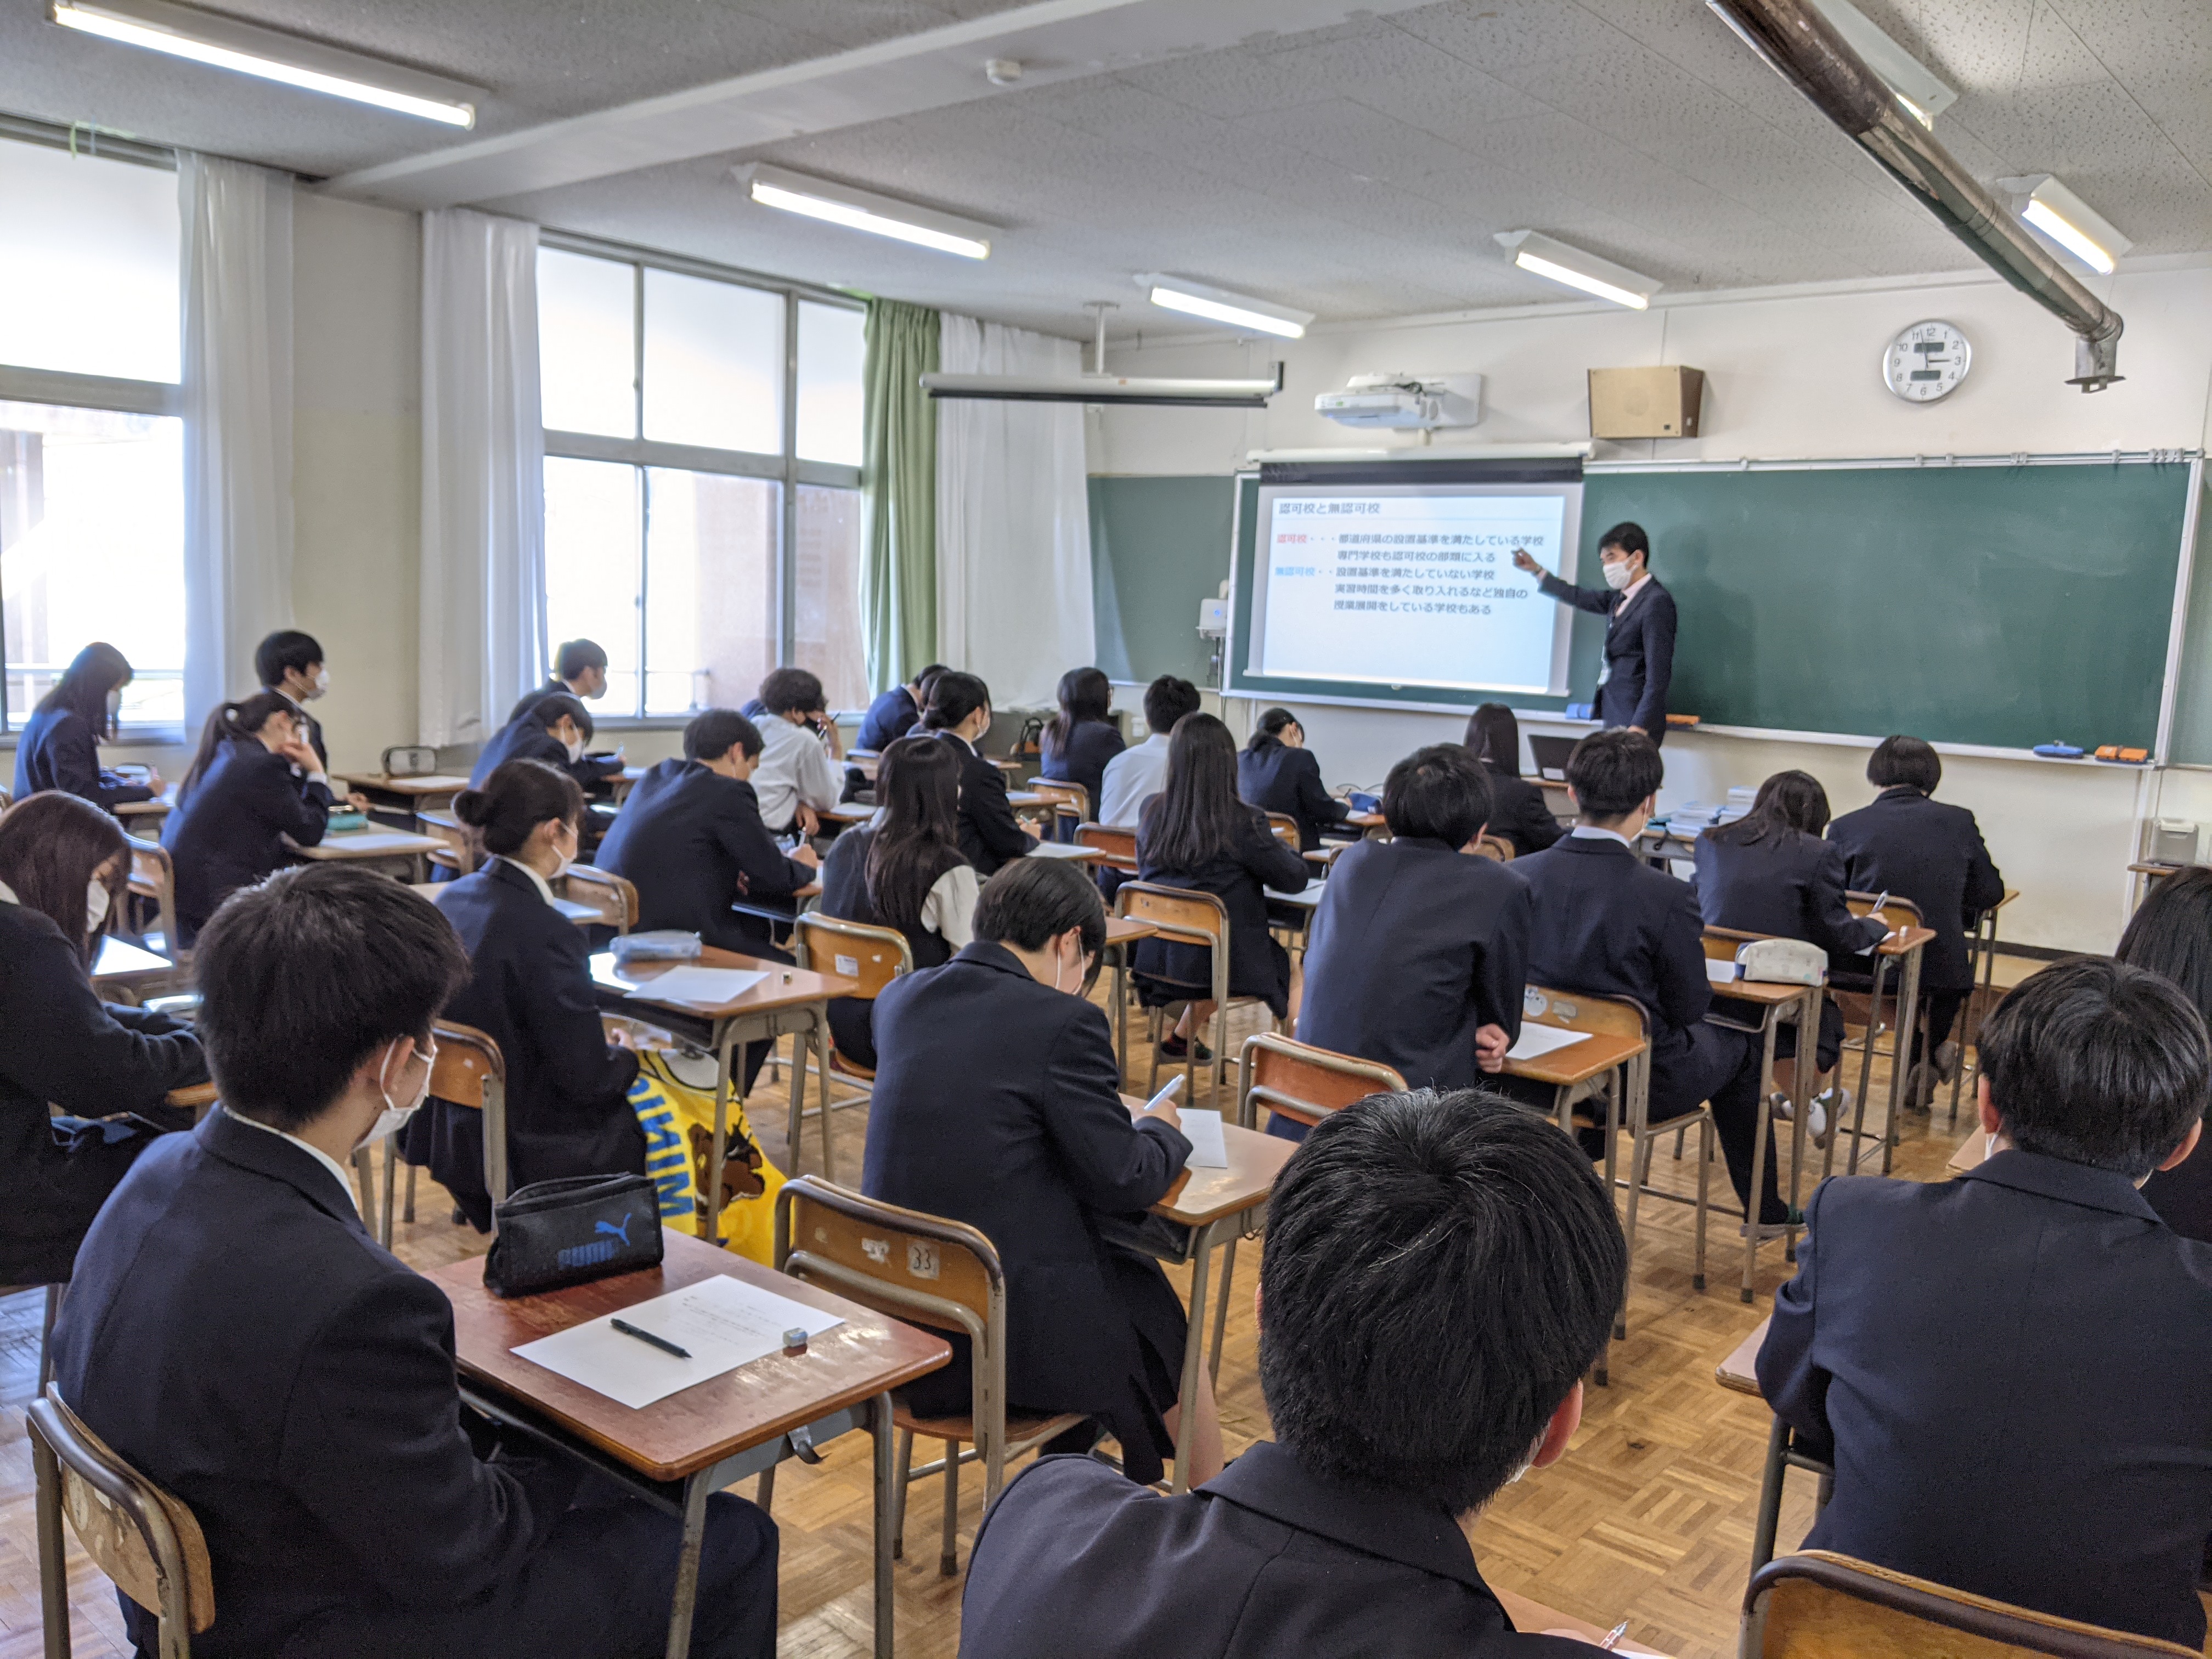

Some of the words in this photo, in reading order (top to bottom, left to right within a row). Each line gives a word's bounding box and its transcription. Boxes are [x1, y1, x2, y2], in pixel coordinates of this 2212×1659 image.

[1912, 332, 1919, 340] 11
[1926, 328, 1936, 336] 12
[1899, 343, 1908, 352] 10
[1952, 340, 1959, 349] 2
[1894, 359, 1900, 367] 9
[1954, 357, 1961, 365] 3
[1896, 374, 1902, 382] 8
[1948, 372, 1954, 380] 4
[1906, 383, 1912, 392] 7
[1920, 387, 1926, 396] 6
[1936, 383, 1943, 391] 5
[1279, 503, 1380, 515] 認可校と無認可校
[1338, 550, 1495, 562] 専門学校も認可校の部類に入る
[1335, 583, 1528, 599] 実習時間を多く取り入れるなど独自の
[1333, 600, 1491, 615] 授業展開をしている学校もある
[913, 1246, 931, 1269] 33
